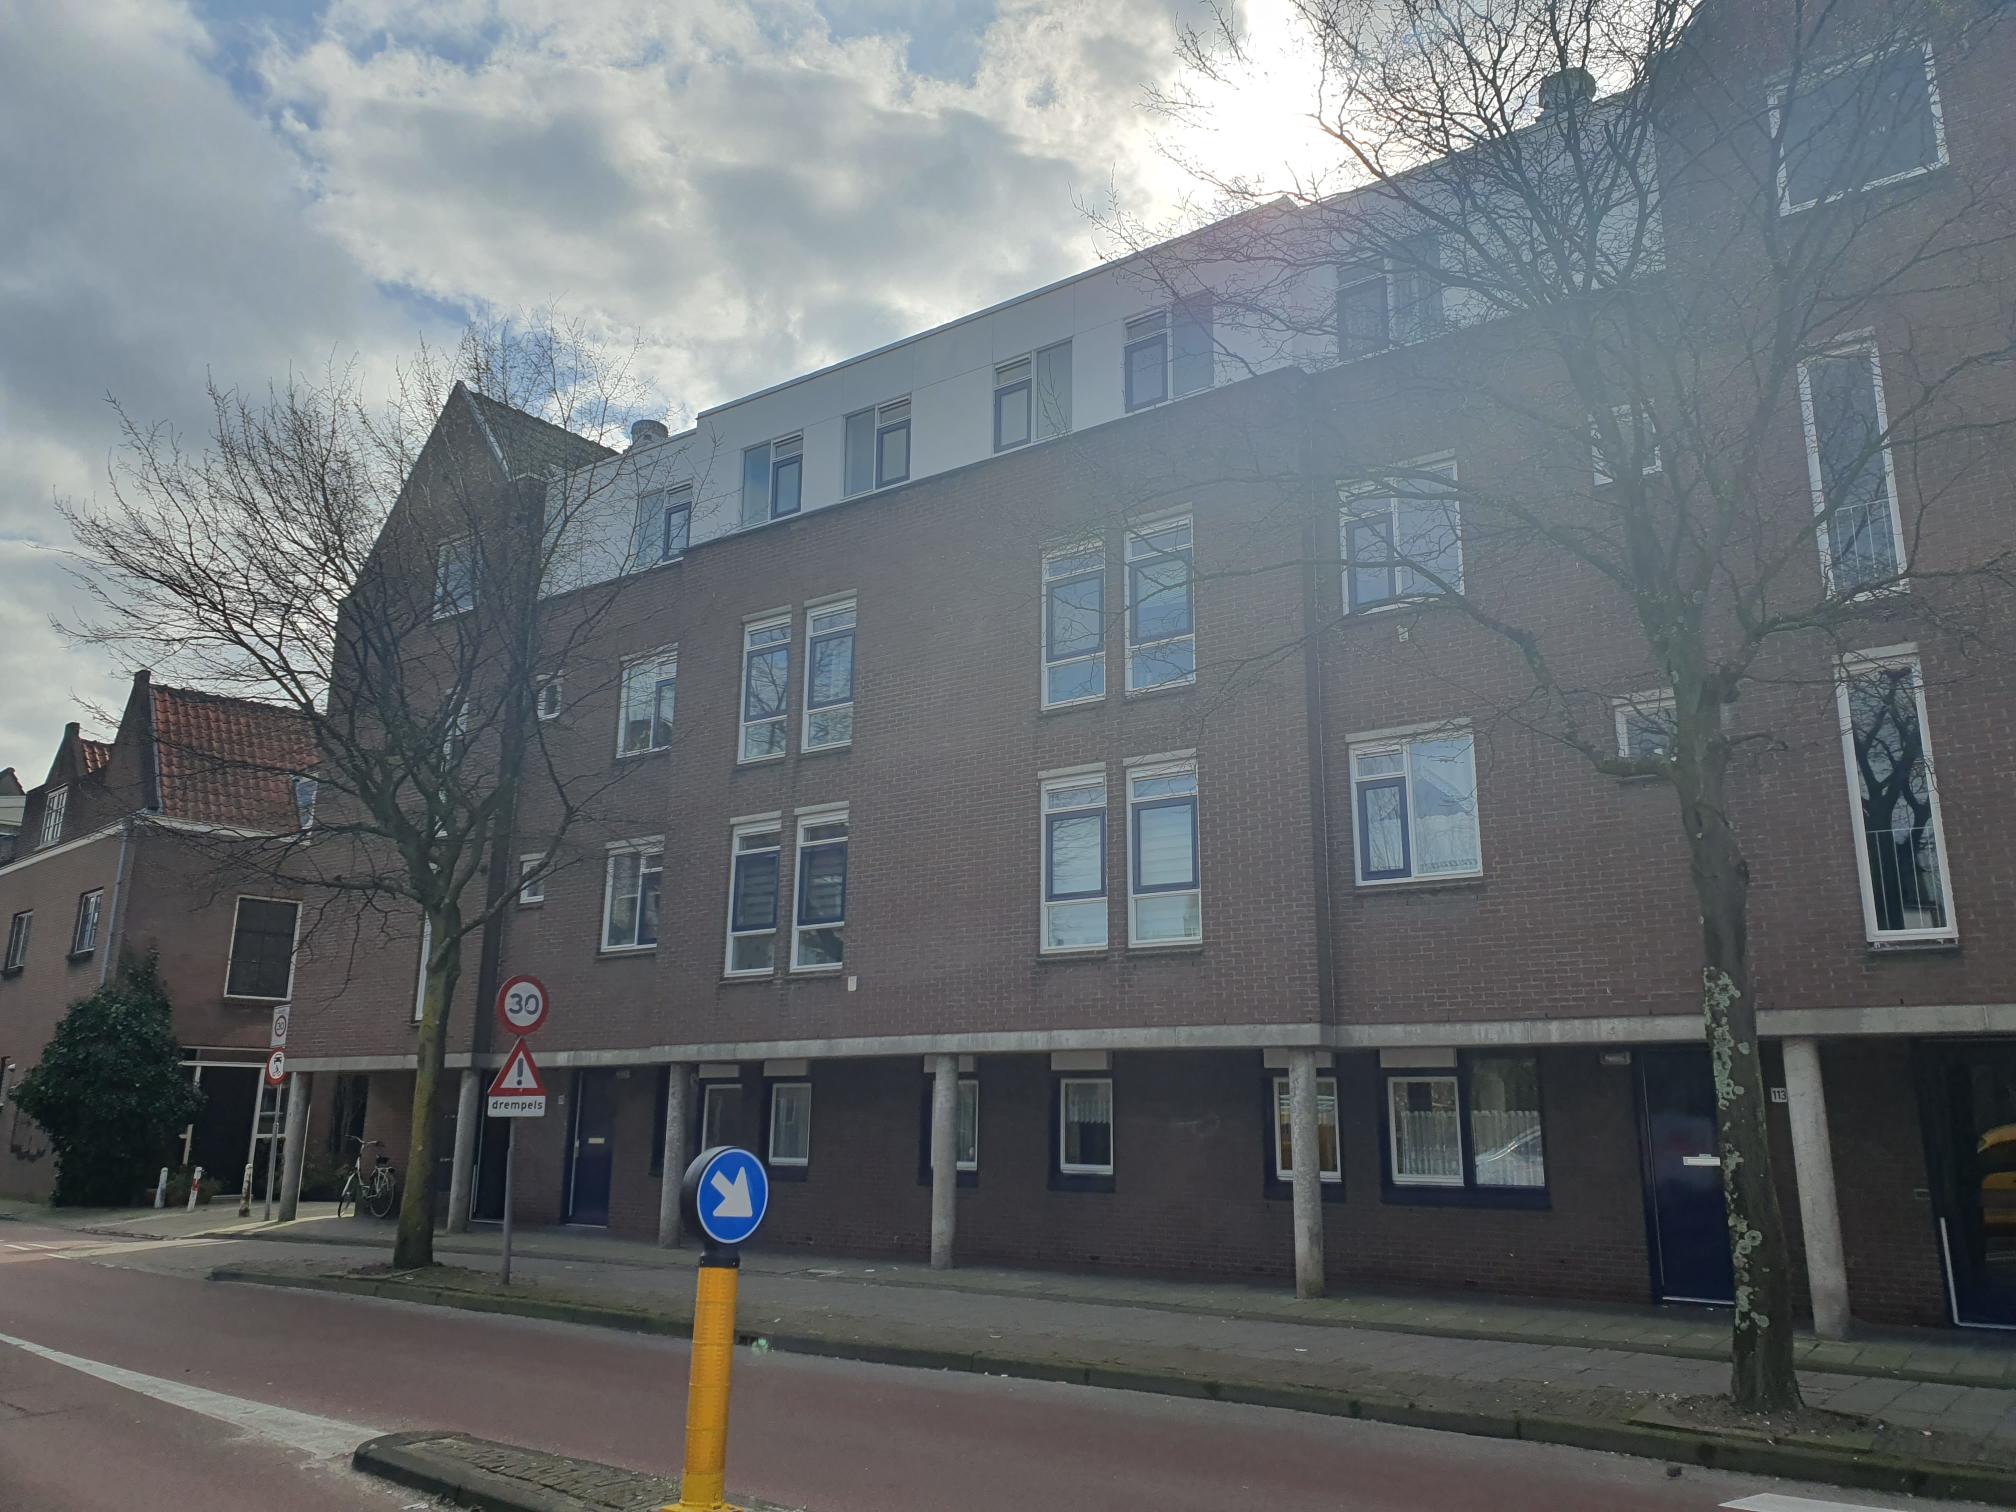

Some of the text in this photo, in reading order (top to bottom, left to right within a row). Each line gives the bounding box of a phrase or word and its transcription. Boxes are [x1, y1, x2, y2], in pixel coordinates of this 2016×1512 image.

[509, 993, 540, 1015] 30
[1772, 1090, 1787, 1100] 113
[492, 1100, 543, 1111] drempels
